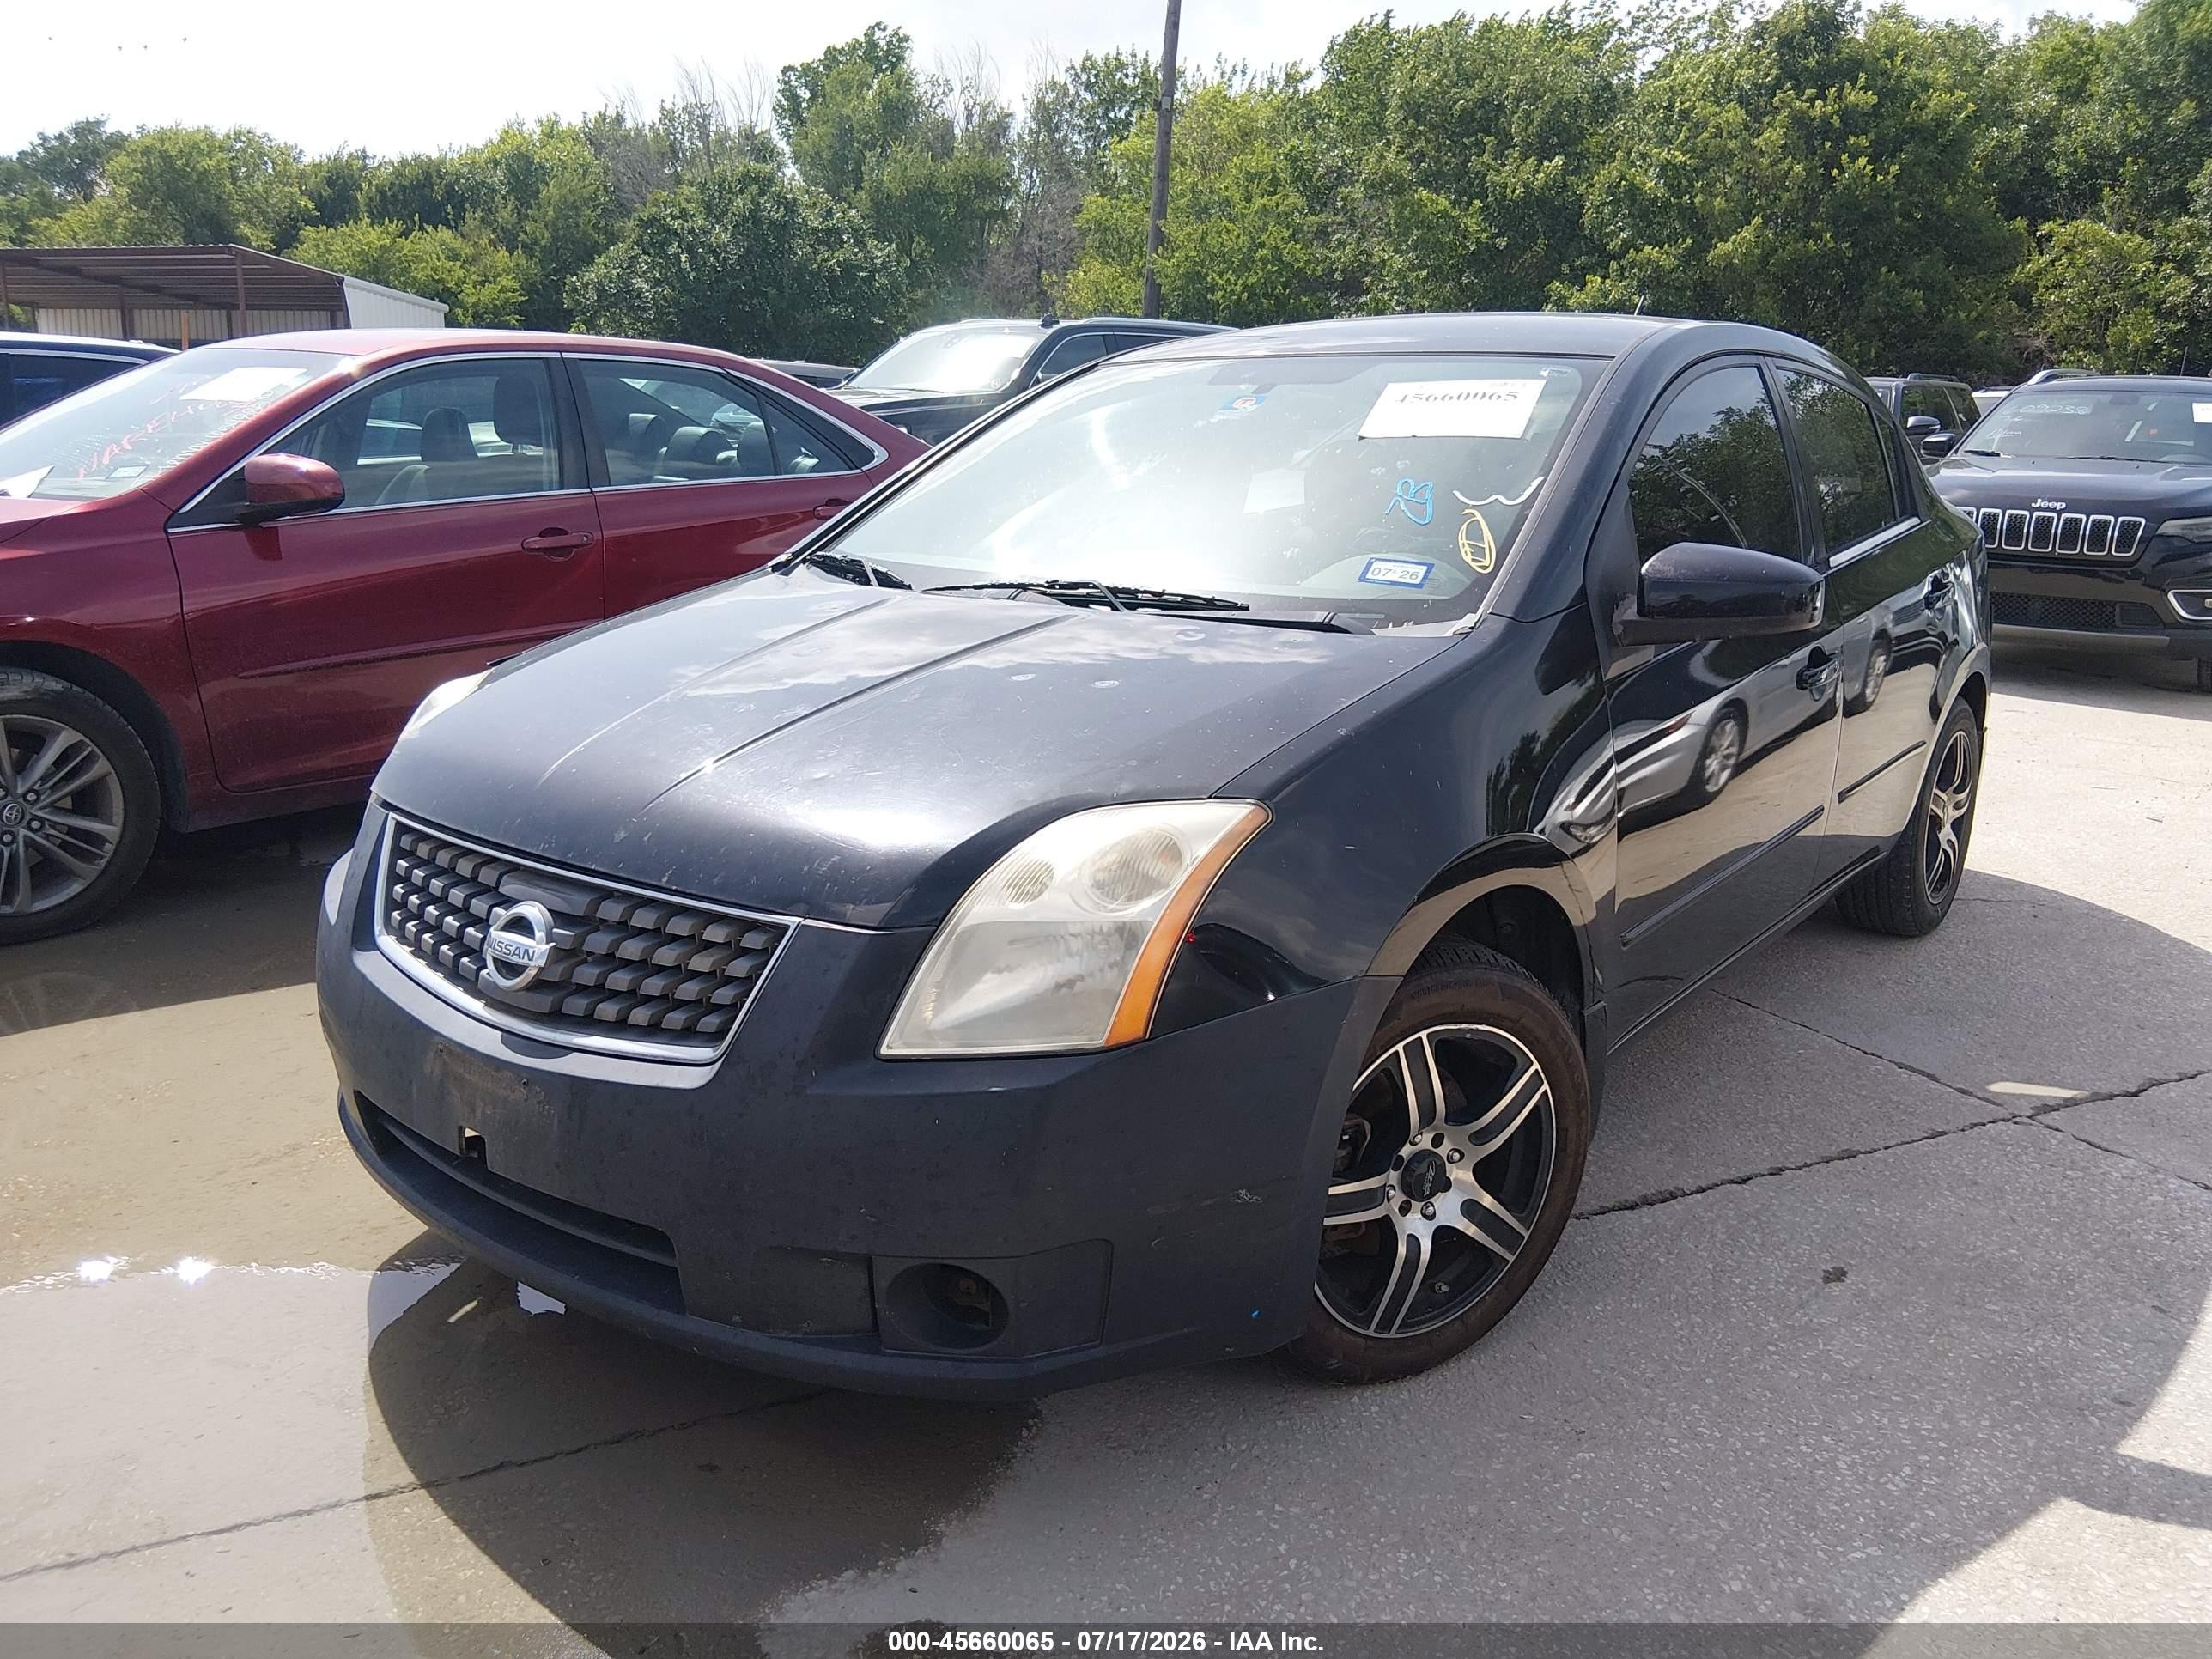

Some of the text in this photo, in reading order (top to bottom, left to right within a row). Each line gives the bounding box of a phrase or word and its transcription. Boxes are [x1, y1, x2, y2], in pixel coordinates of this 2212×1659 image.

[2031, 498, 2066, 510] Jeep
[1398, 569, 1421, 580] 26
[488, 937, 536, 962] NISSAN
